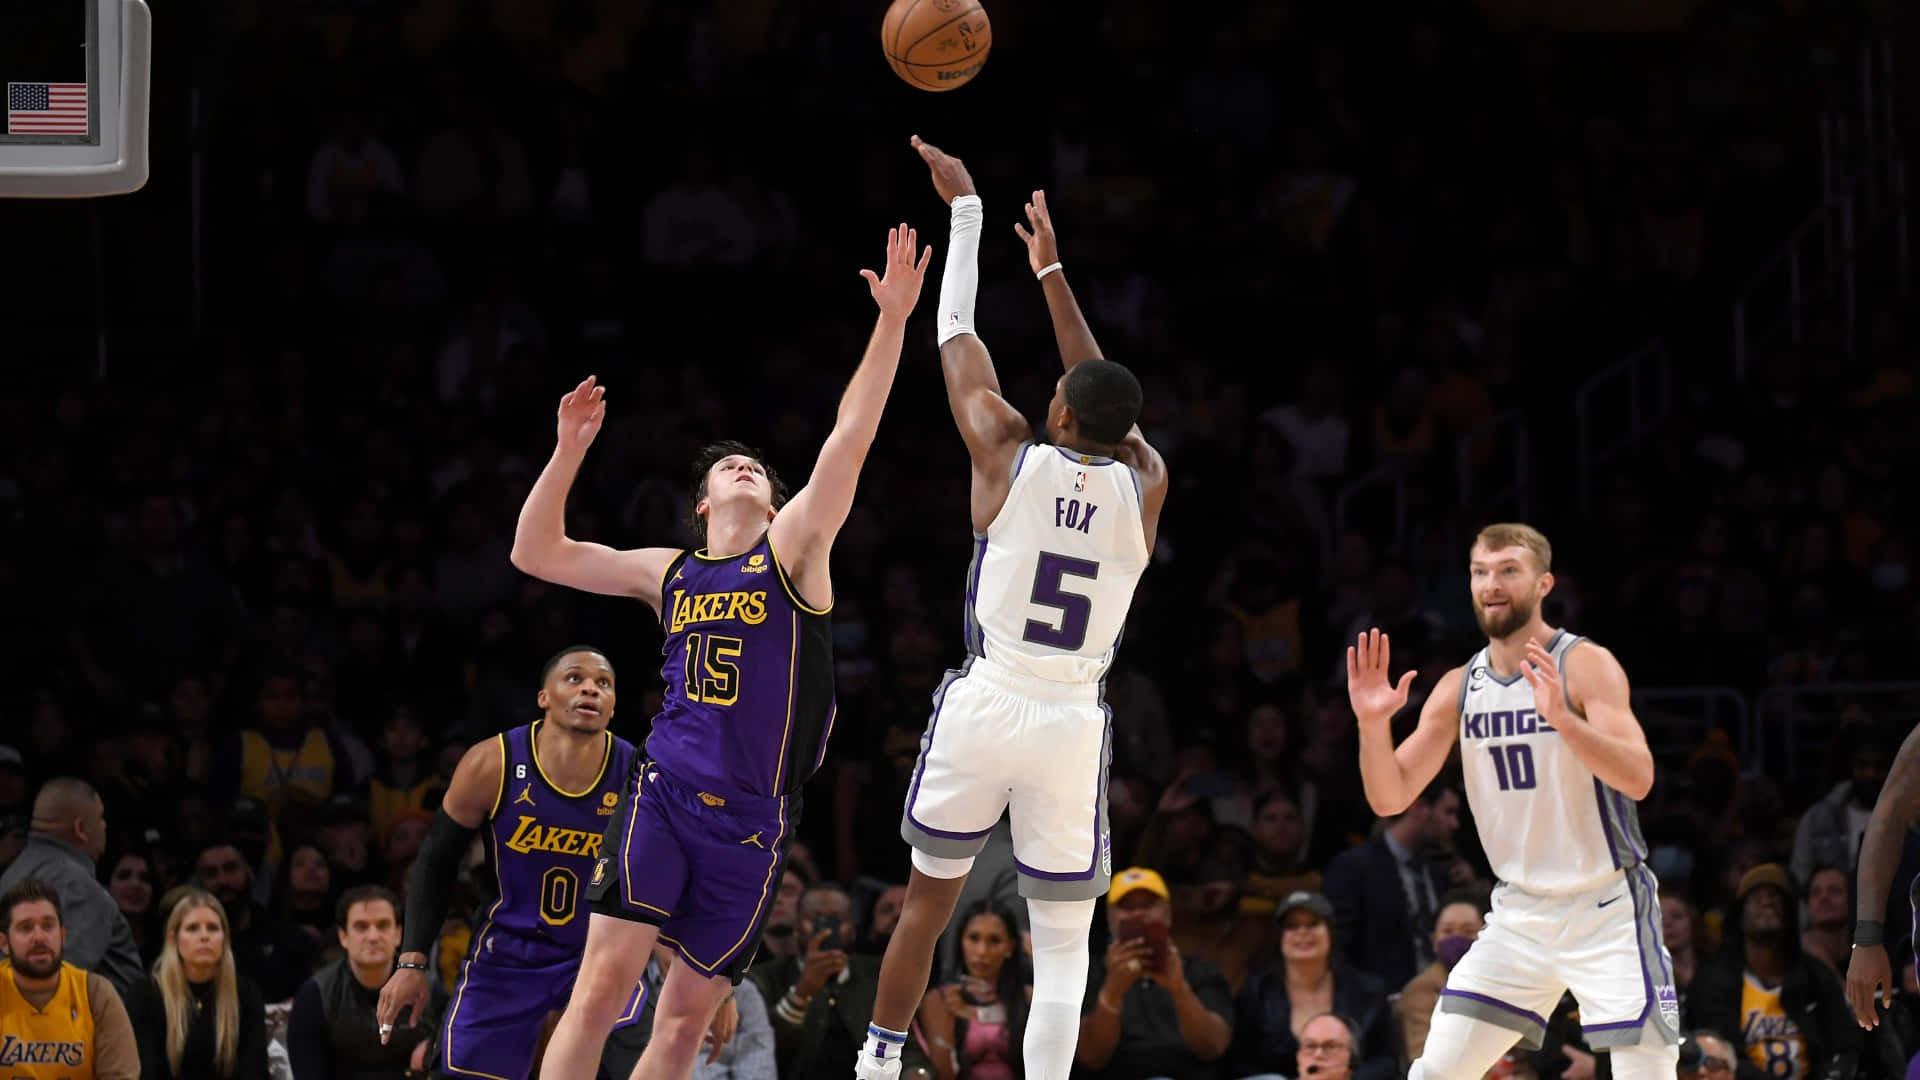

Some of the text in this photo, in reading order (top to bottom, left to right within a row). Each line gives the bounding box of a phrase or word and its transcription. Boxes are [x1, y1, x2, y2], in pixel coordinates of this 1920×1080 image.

[1055, 497, 1098, 534] FOX
[741, 564, 768, 574] bibigo
[670, 589, 768, 634] LAKERS
[1022, 551, 1100, 651] 5
[685, 632, 743, 707] 15
[1471, 666, 1486, 681] 6
[515, 764, 527, 779] 6
[1488, 743, 1537, 791] 10
[596, 807, 615, 816] bibi
[505, 815, 604, 860] LAKER
[540, 866, 579, 926] 0
[0, 1034, 85, 1068] LAKERS
[1765, 1039, 1797, 1080] 8
